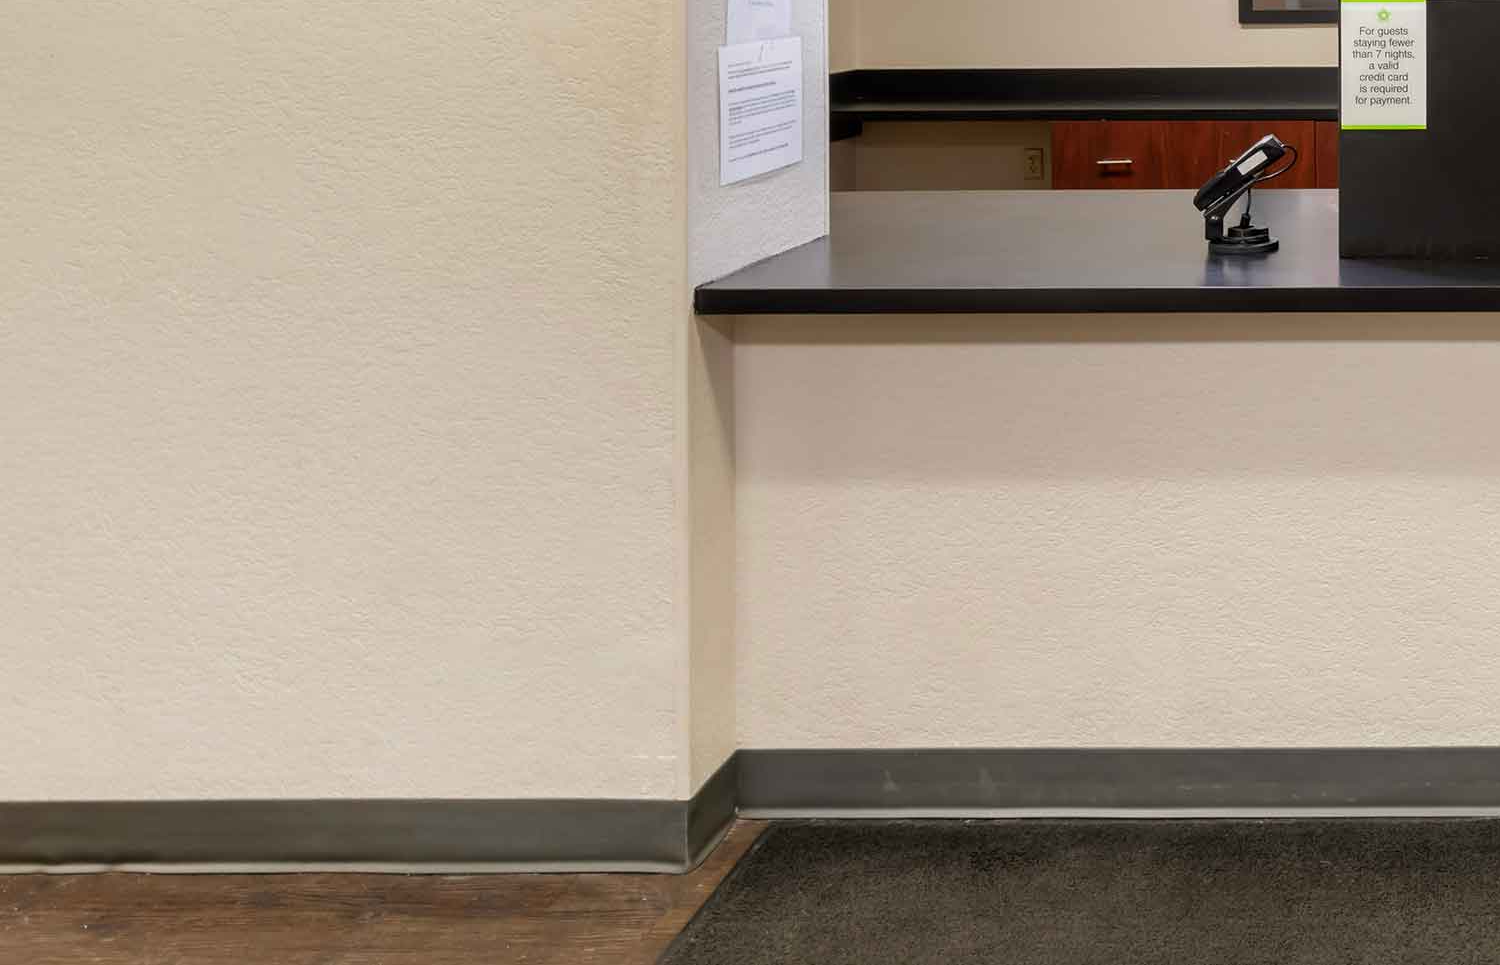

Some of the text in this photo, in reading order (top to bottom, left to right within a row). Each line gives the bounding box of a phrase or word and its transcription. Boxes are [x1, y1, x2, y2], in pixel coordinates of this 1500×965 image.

[1359, 26, 1409, 38] For guests
[1353, 38, 1415, 50] staying fewer
[1352, 49, 1415, 61] than 7 nights,
[1368, 61, 1399, 70] a valid
[1359, 72, 1409, 82] credit card
[1359, 84, 1409, 96] is required
[1355, 95, 1367, 105] for
